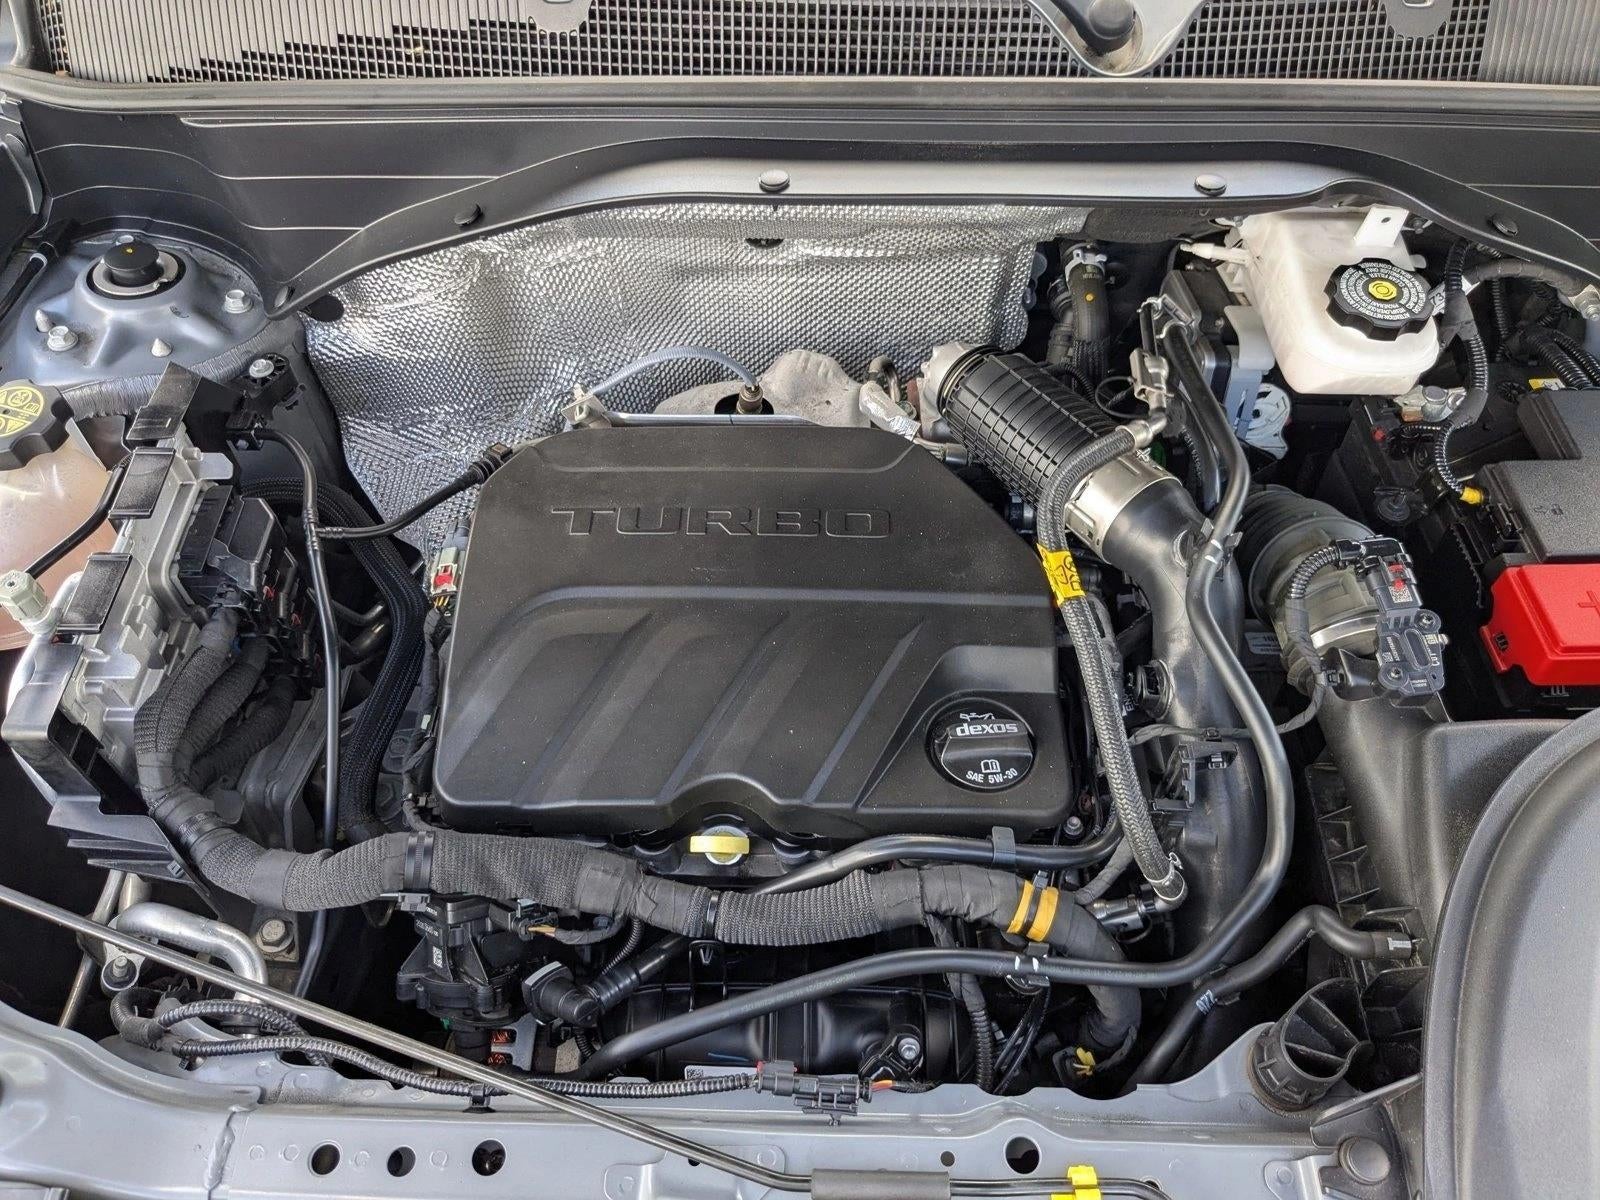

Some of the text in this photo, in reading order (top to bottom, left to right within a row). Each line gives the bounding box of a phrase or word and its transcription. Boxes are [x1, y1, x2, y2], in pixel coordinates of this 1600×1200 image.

[551, 507, 891, 538] TURBO
[956, 723, 1018, 737] dexos
[966, 768, 1018, 784] SAE 5W-30
